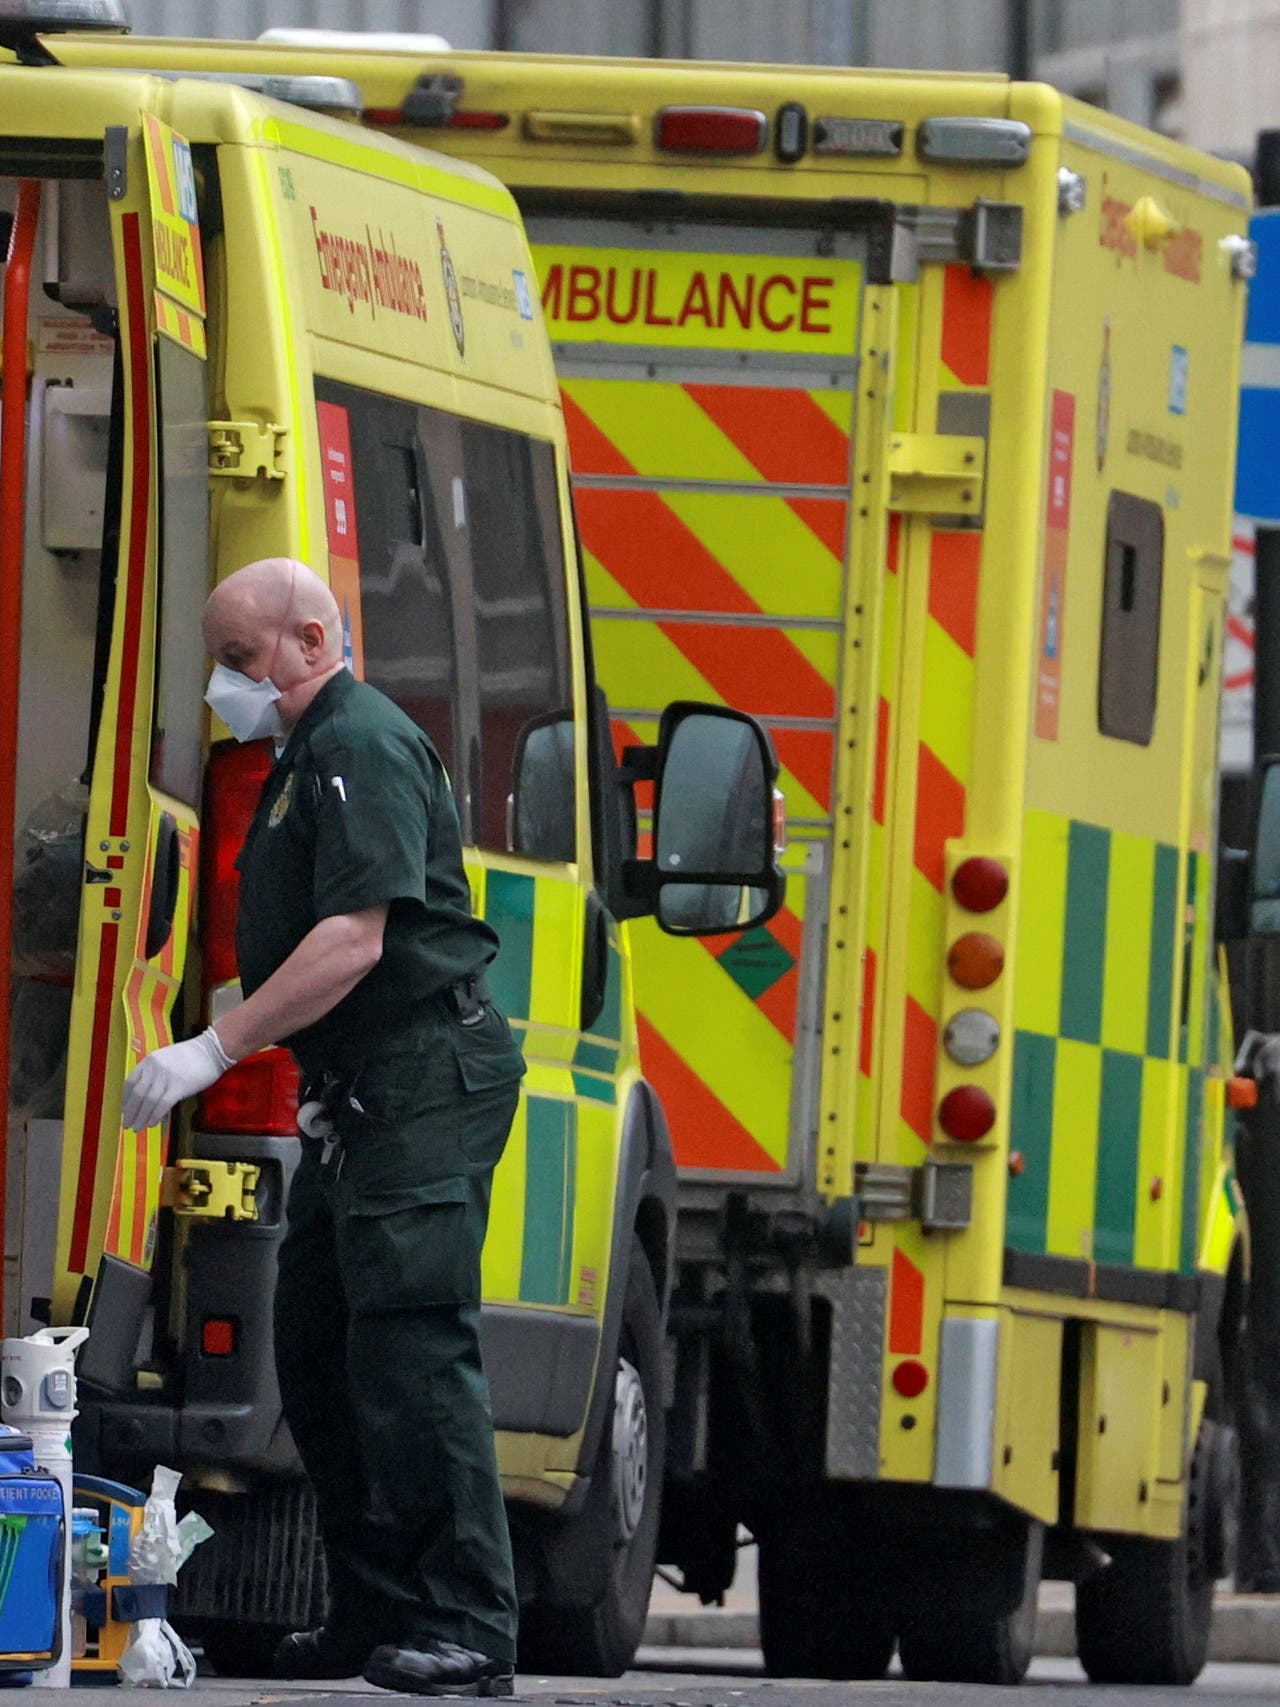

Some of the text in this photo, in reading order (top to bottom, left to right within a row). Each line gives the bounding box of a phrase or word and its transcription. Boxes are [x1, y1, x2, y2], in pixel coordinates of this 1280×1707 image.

[310, 206, 427, 323] Emergency Ambulance
[541, 264, 834, 334] MBULANCE
[31, 1487, 59, 1500] POCKE
